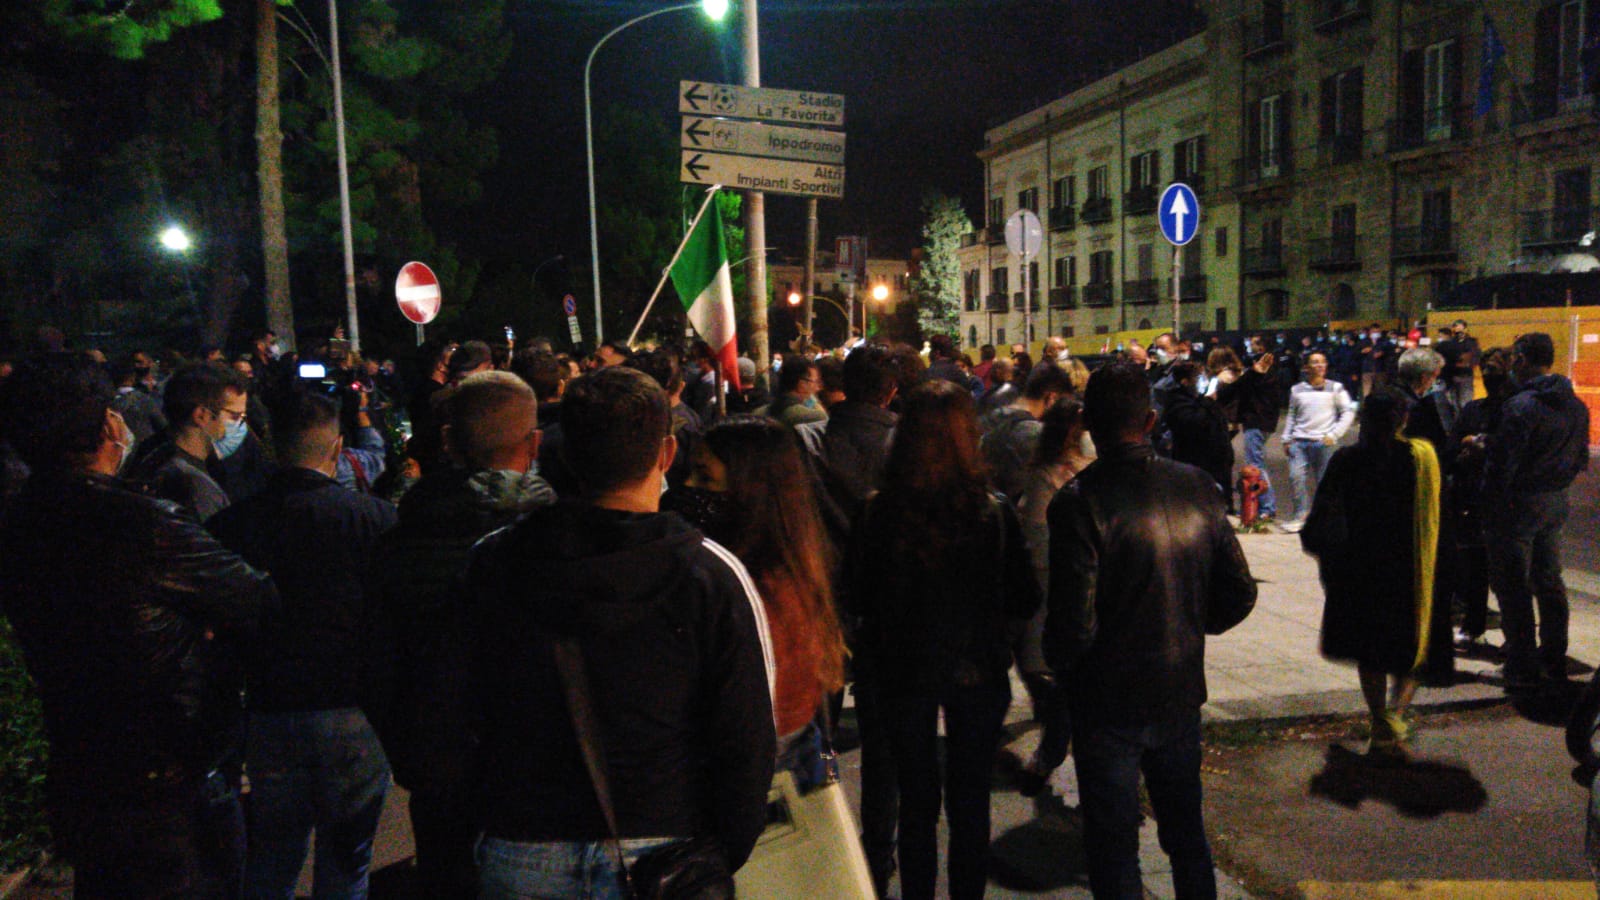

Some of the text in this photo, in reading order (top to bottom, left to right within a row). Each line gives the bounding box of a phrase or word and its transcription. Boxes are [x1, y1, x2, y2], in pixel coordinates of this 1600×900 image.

[799, 93, 842, 108] Stadio
[757, 104, 773, 117] La
[768, 135, 842, 154] Ippodromo
[814, 167, 842, 180] Altri
[737, 173, 841, 195] Impianti Sportivi
